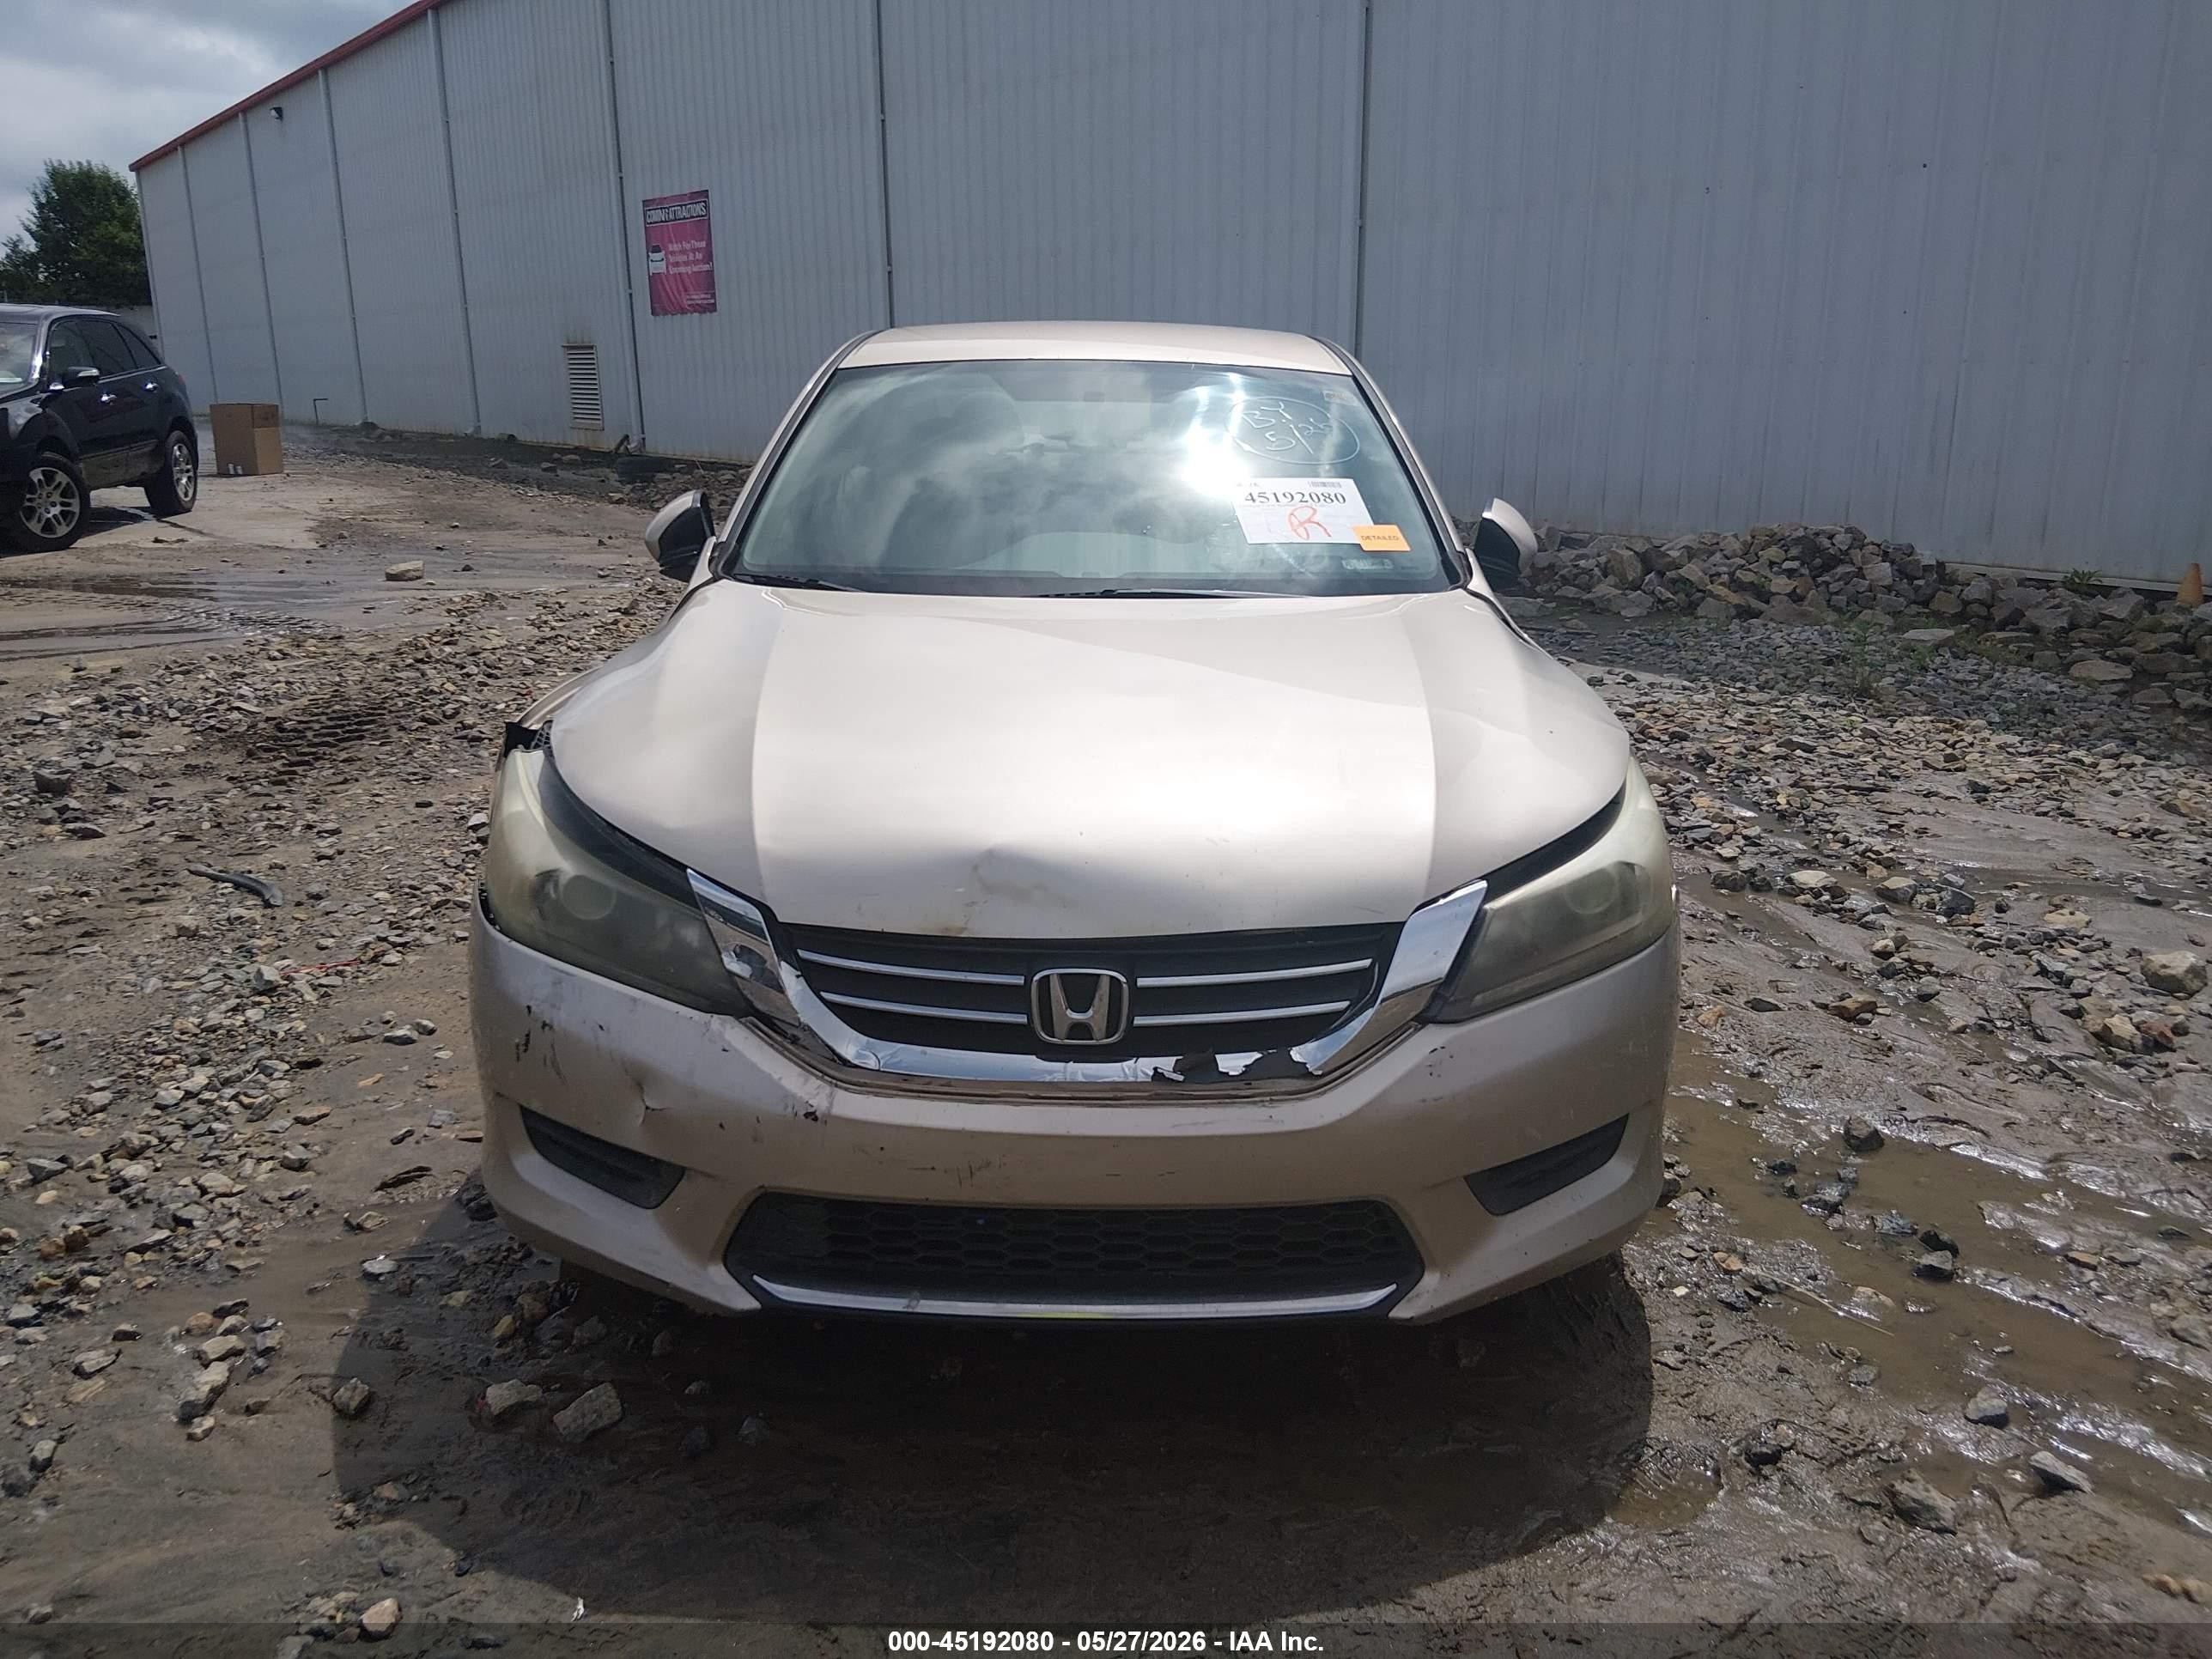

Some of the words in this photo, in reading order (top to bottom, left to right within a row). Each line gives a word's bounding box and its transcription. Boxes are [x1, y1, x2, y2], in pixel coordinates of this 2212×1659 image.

[669, 202, 707, 221] ATTRACTIONS
[1244, 491, 1347, 505] 45192080
[1287, 505, 1333, 541] R
